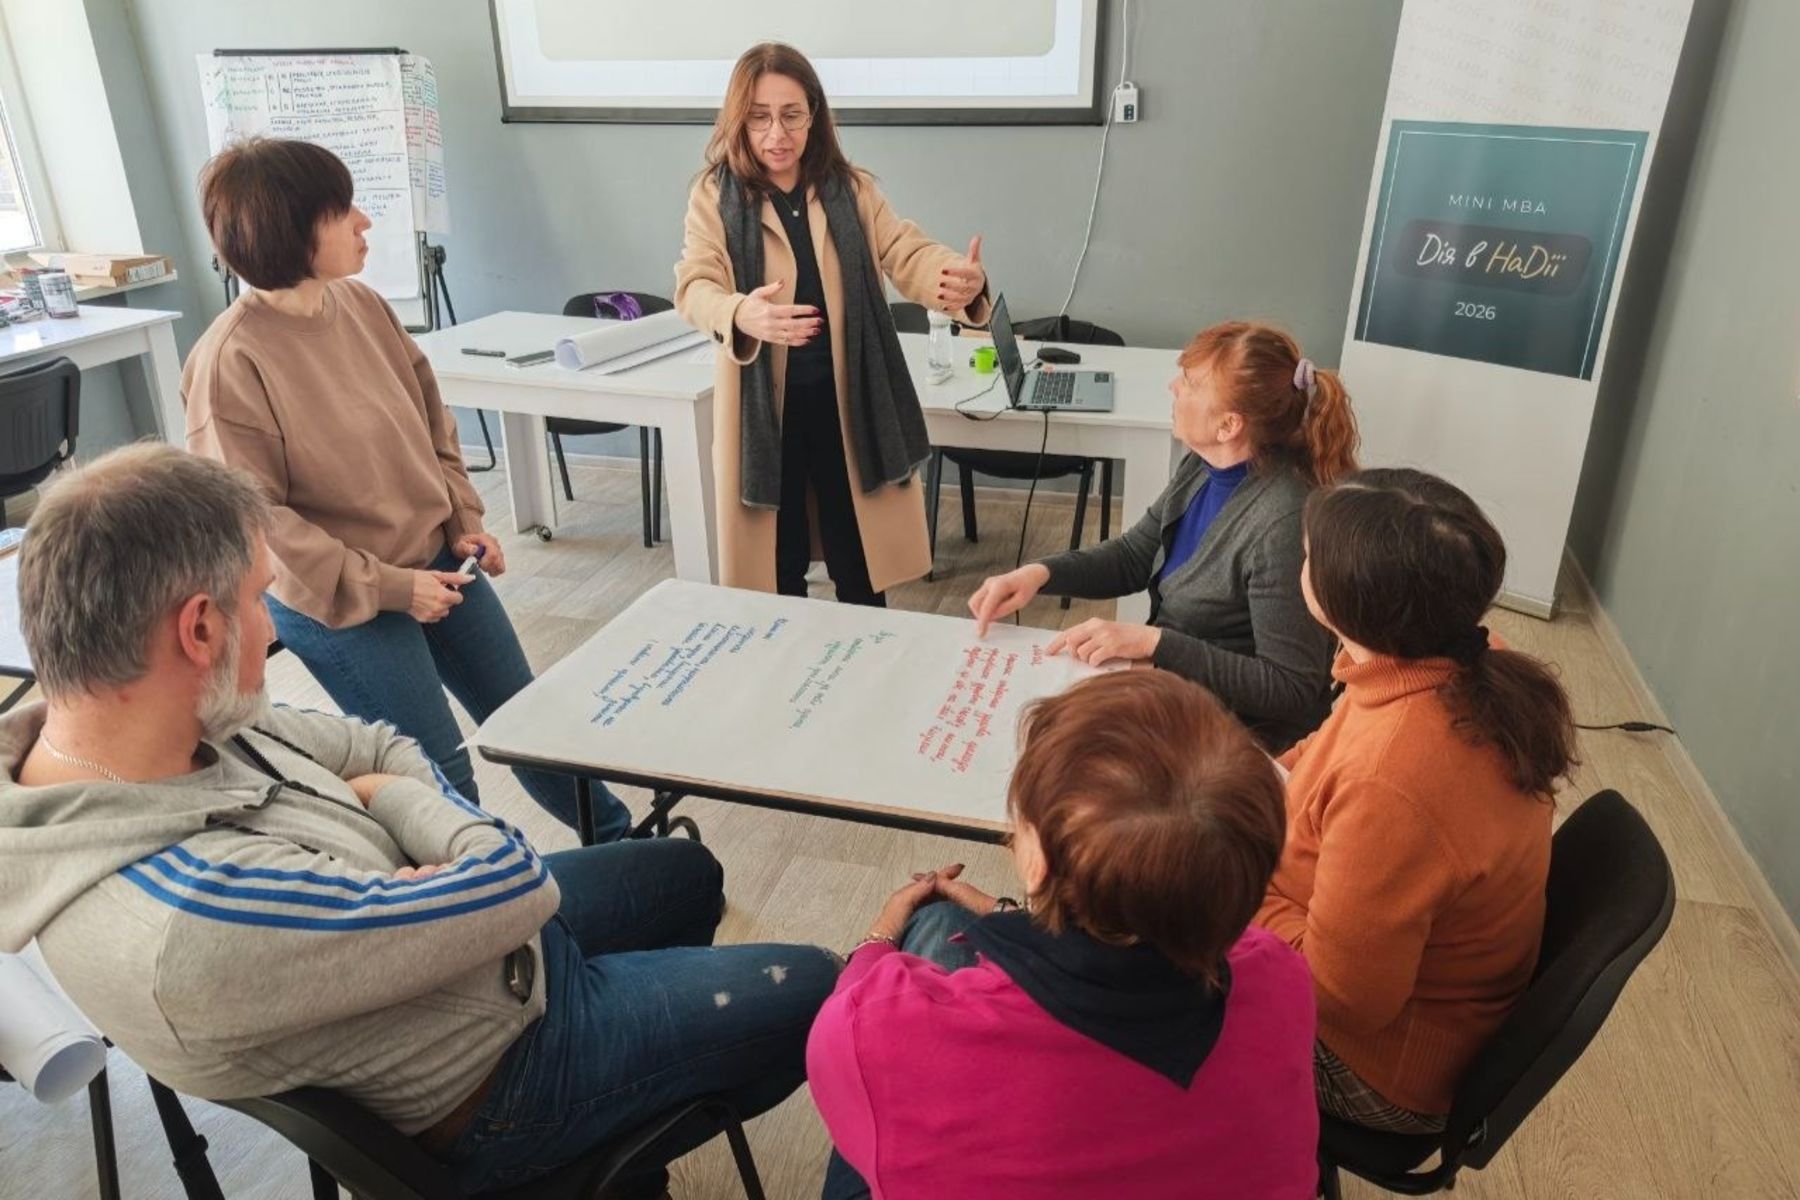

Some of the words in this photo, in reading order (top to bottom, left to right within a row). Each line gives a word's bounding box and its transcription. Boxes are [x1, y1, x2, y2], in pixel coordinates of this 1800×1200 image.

[1449, 194, 1493, 210] MINI
[1502, 199, 1546, 215] MBA
[1455, 302, 1497, 320] 2026
